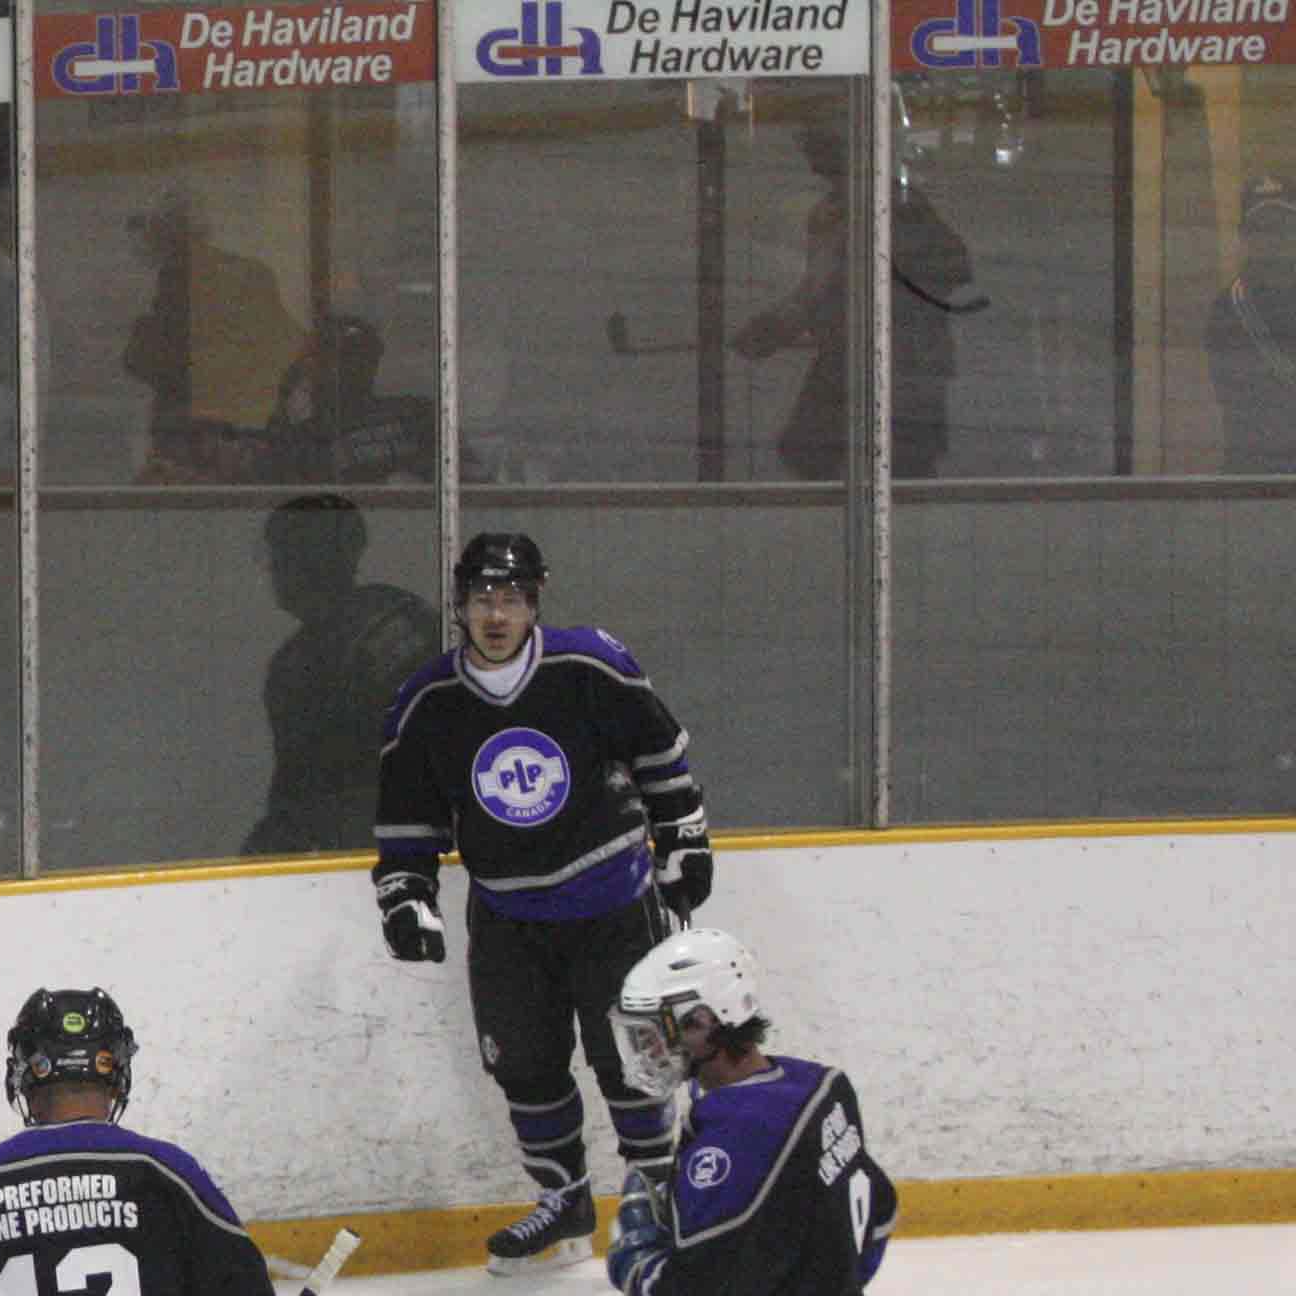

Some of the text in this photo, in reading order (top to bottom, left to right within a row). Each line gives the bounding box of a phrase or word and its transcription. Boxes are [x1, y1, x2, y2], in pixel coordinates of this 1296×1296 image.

[180, 6, 417, 50] De Haviland
[607, 0, 845, 34] De Haviland
[1042, 0, 1289, 29] De Haviland
[629, 38, 824, 76] Hardware
[1066, 25, 1266, 66] Hardware
[203, 48, 393, 89] Hardware
[24, 1200, 139, 1237] PRODUCTS
